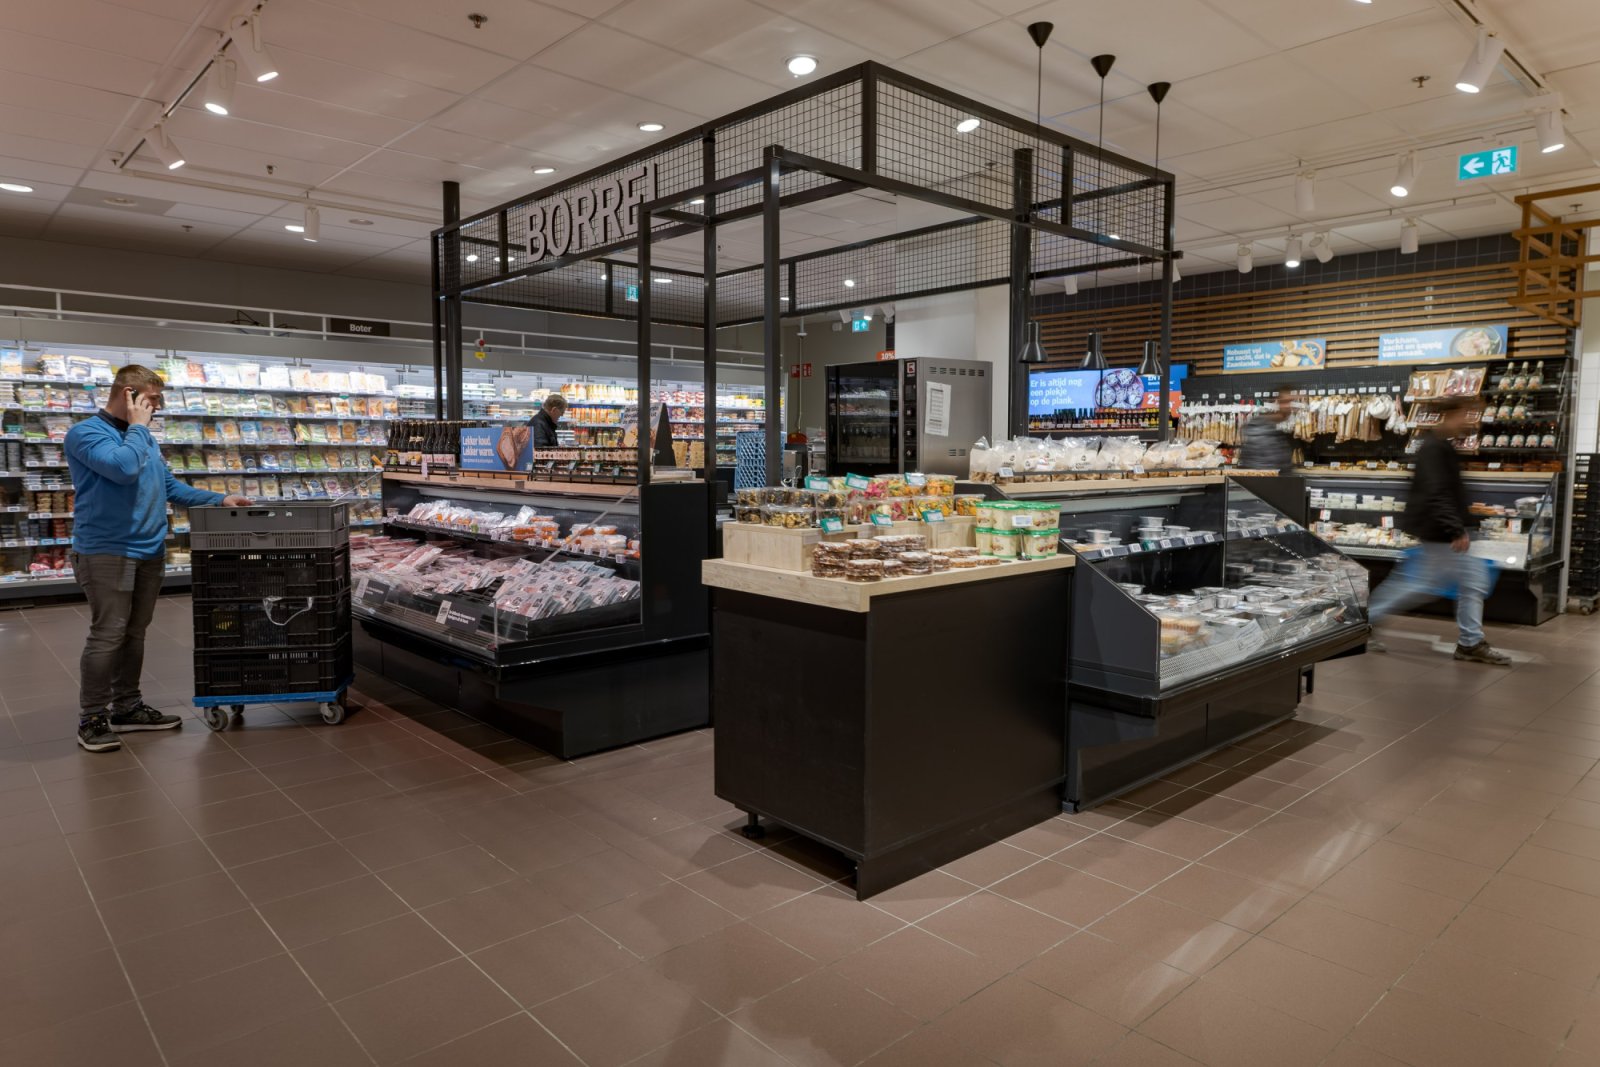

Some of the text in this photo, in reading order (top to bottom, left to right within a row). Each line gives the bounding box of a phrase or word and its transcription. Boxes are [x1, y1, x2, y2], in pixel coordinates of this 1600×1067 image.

[350, 324, 372, 332] Boter
[1048, 378, 1066, 388] altijd
[1068, 378, 1082, 387] nog
[1045, 387, 1068, 396] plekje
[1052, 396, 1074, 406] plank.
[462, 435, 491, 446] Lekker koud.
[462, 446, 478, 456] Lekker
